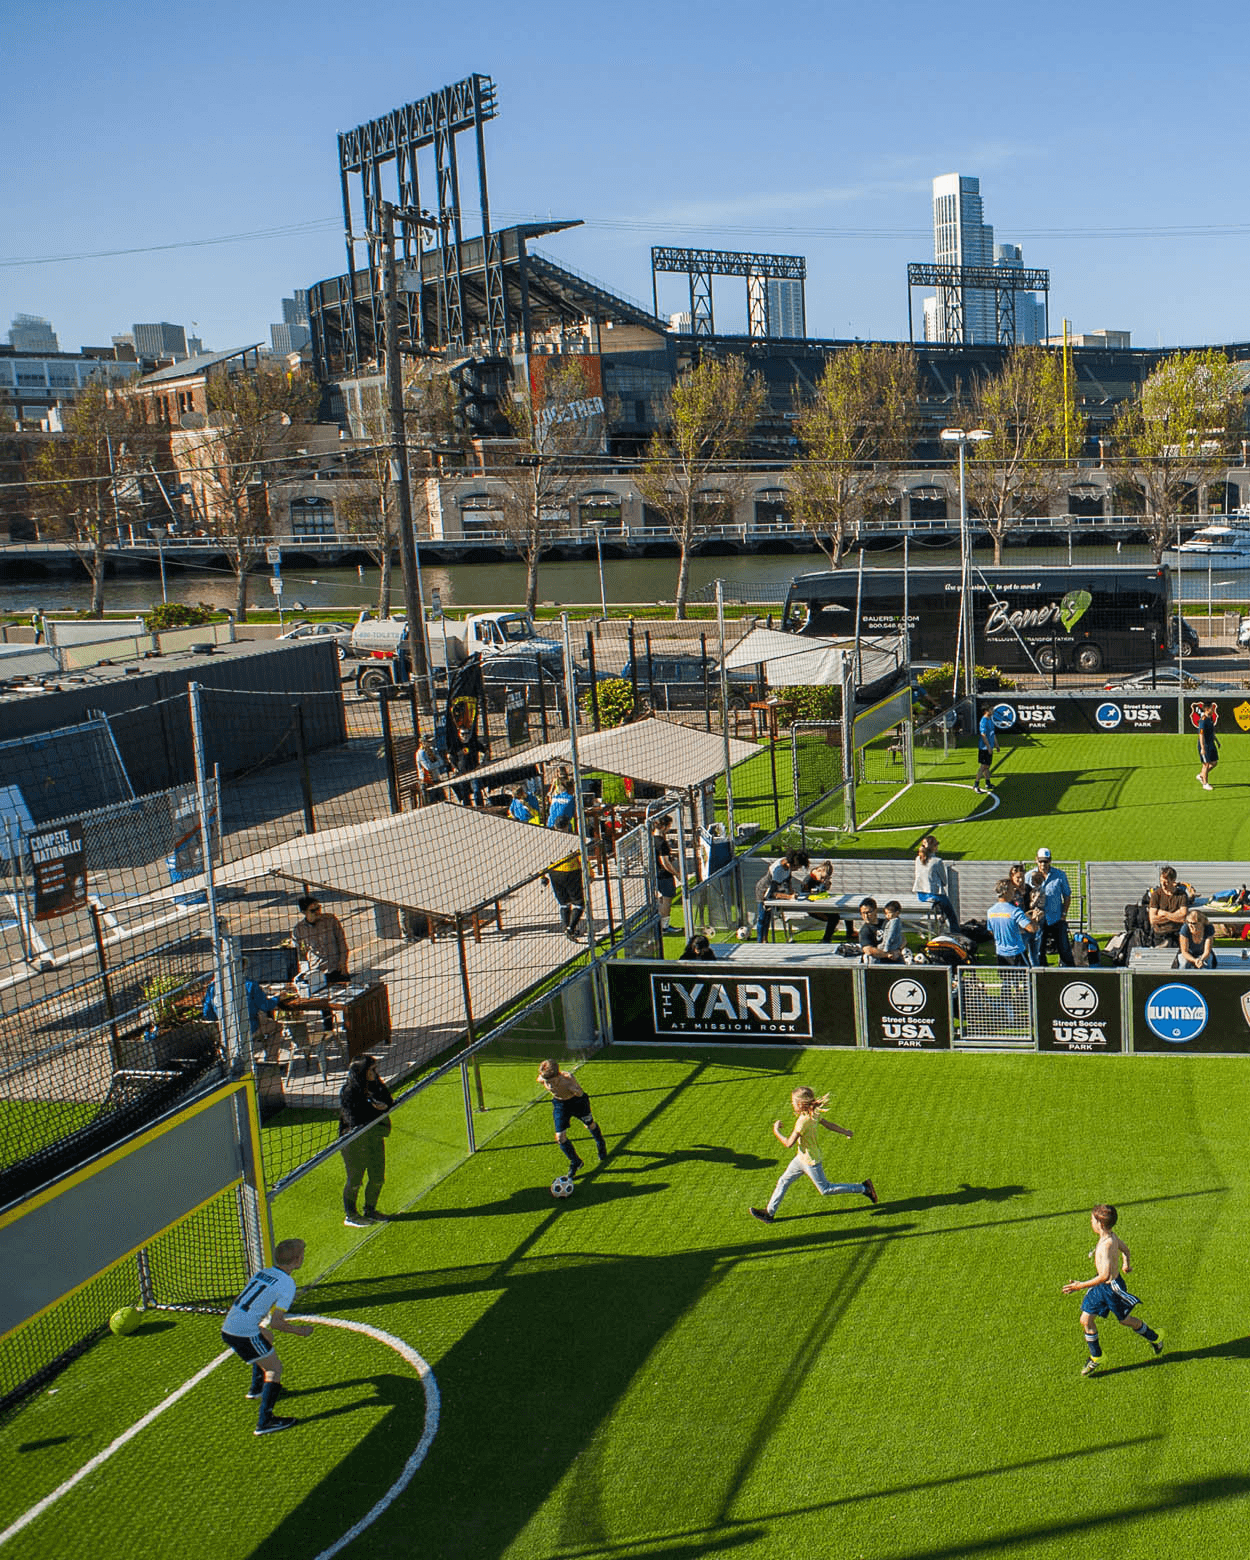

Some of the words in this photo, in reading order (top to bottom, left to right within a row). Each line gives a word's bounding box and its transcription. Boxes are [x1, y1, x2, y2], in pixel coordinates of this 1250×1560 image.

[1018, 710, 1056, 721] USA
[1123, 709, 1162, 720] USA
[30, 829, 70, 851] COMPETE
[660, 982, 672, 1018] THE
[672, 983, 802, 1021] YARD
[907, 1016, 936, 1024] Soccer
[882, 1024, 936, 1039] USA
[1052, 1027, 1107, 1042] USA
[235, 1279, 268, 1313] 11
